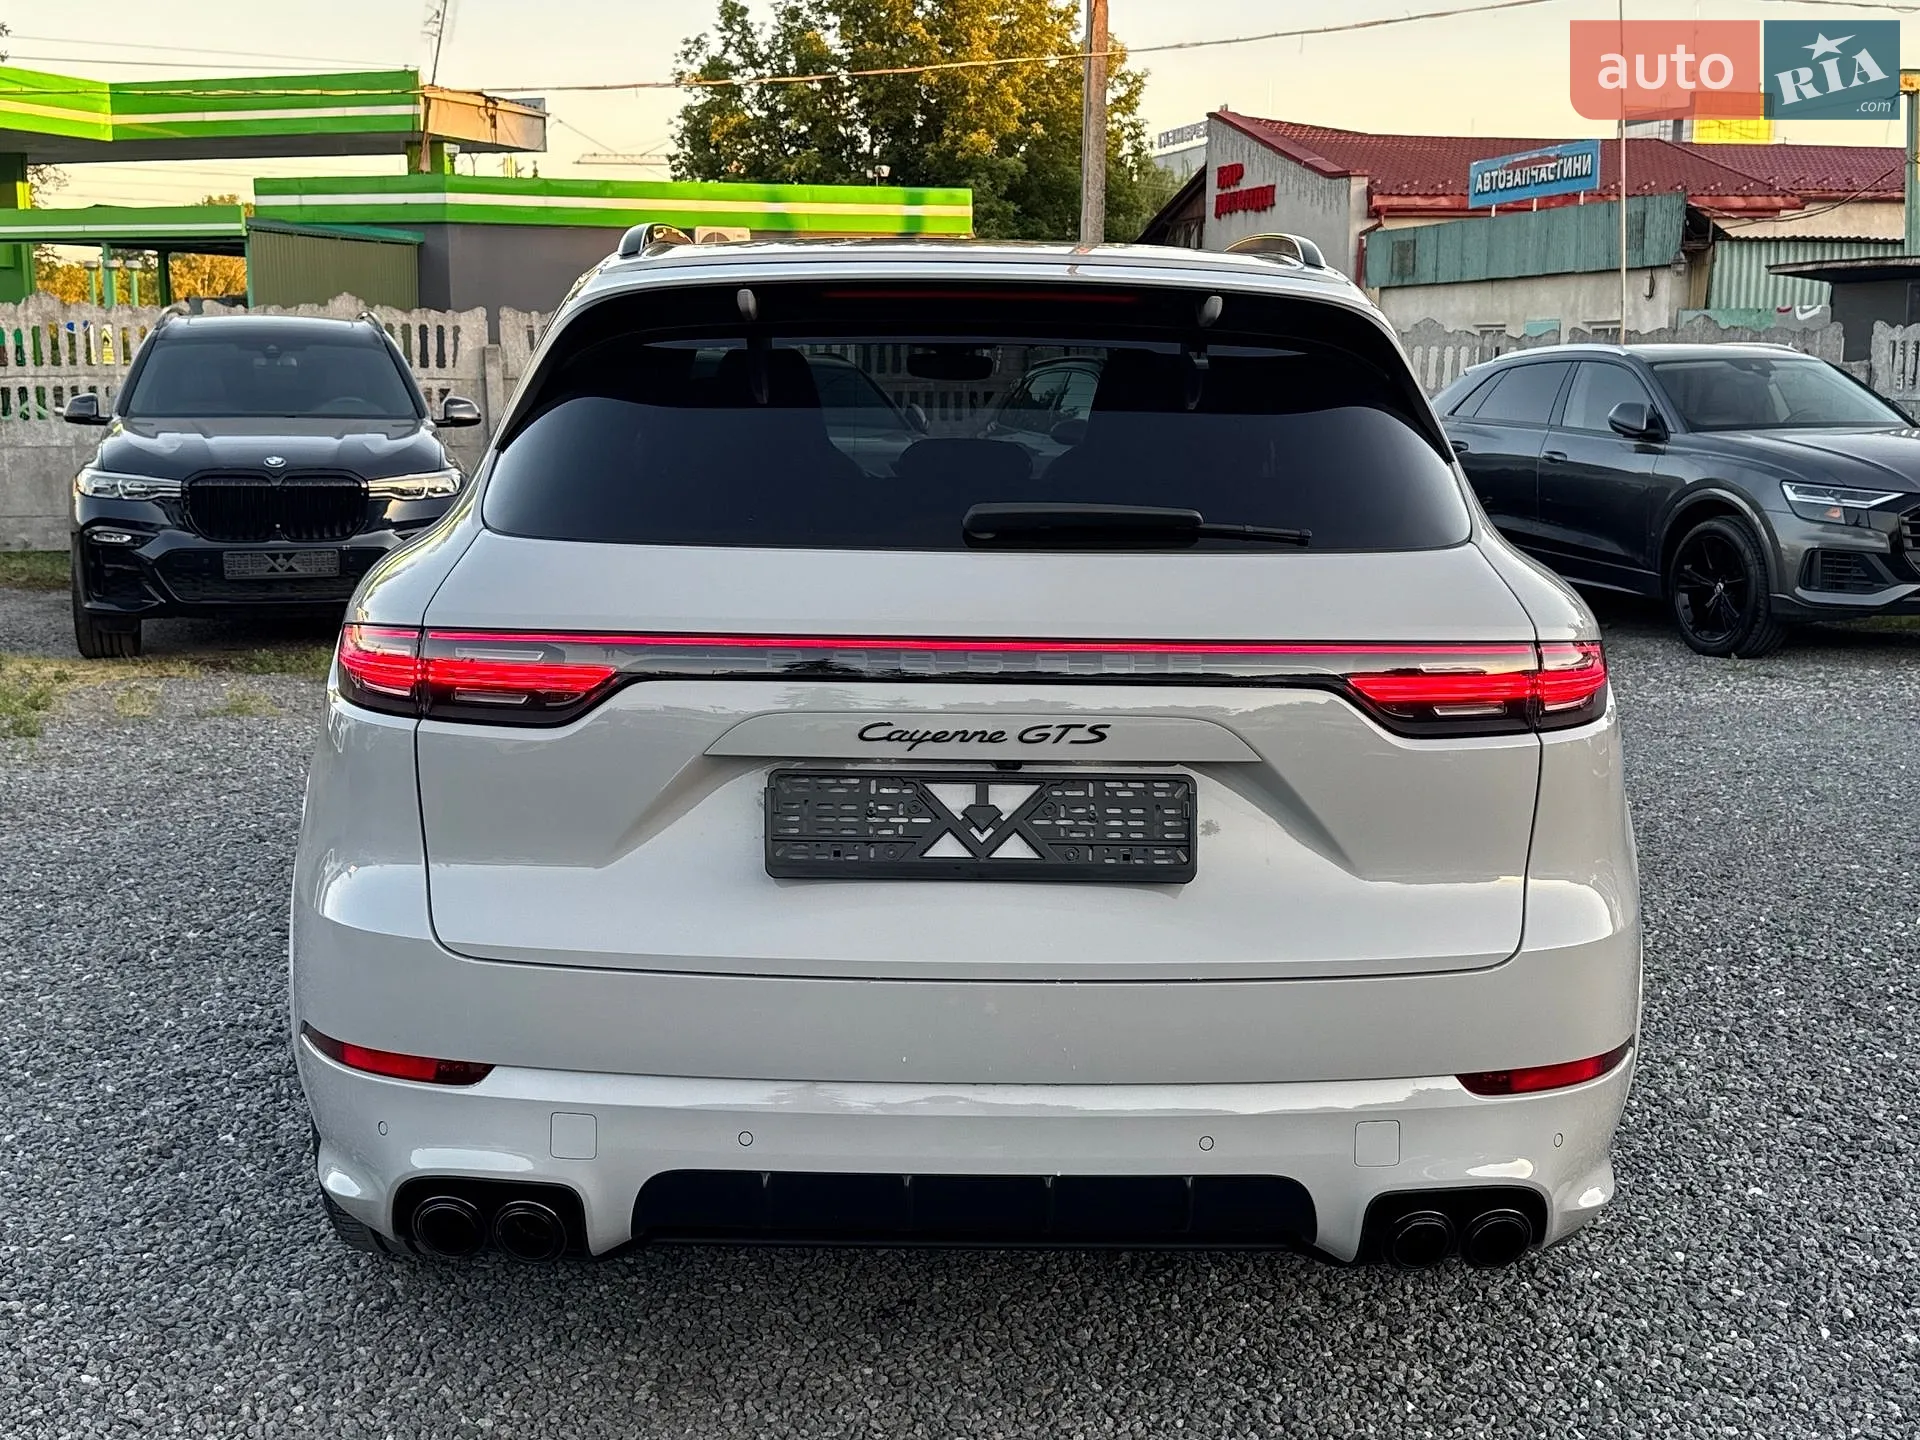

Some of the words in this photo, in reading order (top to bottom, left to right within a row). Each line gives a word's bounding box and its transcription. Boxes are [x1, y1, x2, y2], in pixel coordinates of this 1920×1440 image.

[1474, 153, 1593, 194] АВТОЗАПЧАСТИНИ
[857, 721, 1008, 752] Cayenne
[1017, 723, 1112, 745] GTS
